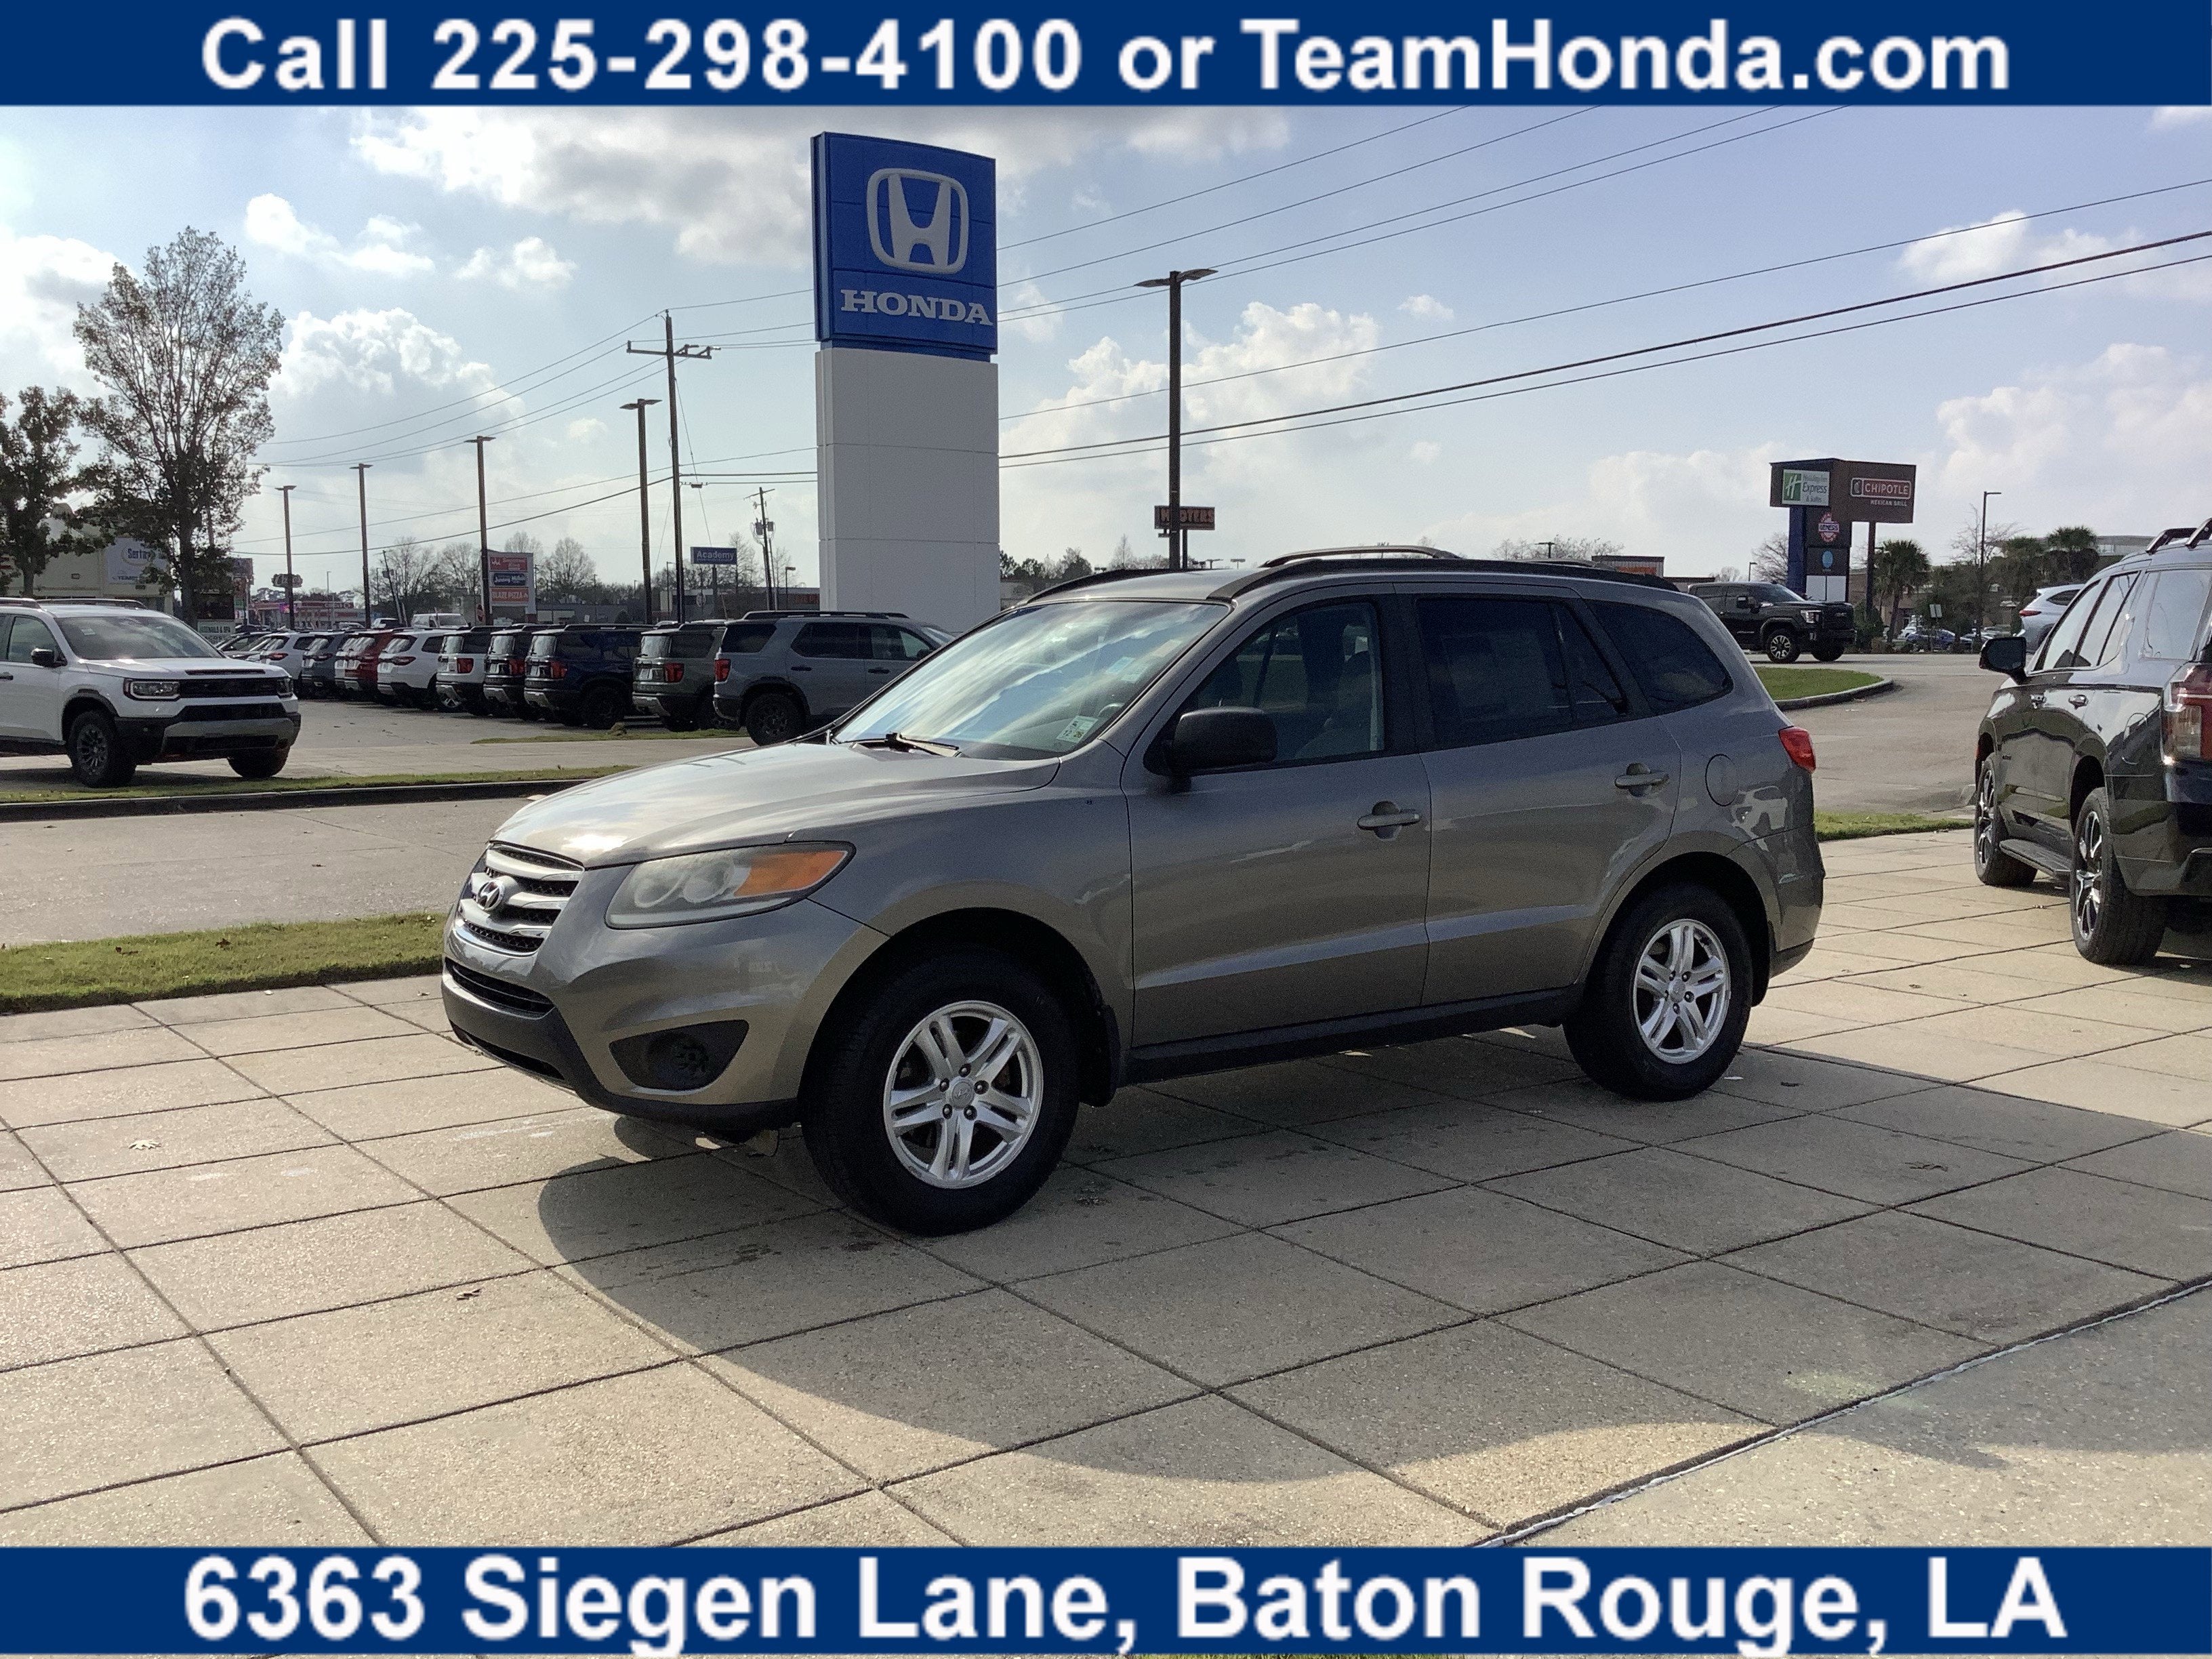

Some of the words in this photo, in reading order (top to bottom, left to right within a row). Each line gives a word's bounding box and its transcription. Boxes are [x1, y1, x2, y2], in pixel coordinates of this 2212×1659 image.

[840, 289, 994, 327] HONDA
[1803, 482, 1827, 495] Express
[1864, 483, 1909, 495] CHIPOTLE
[1160, 508, 1214, 523] HOTERS
[697, 550, 735, 561] Academy
